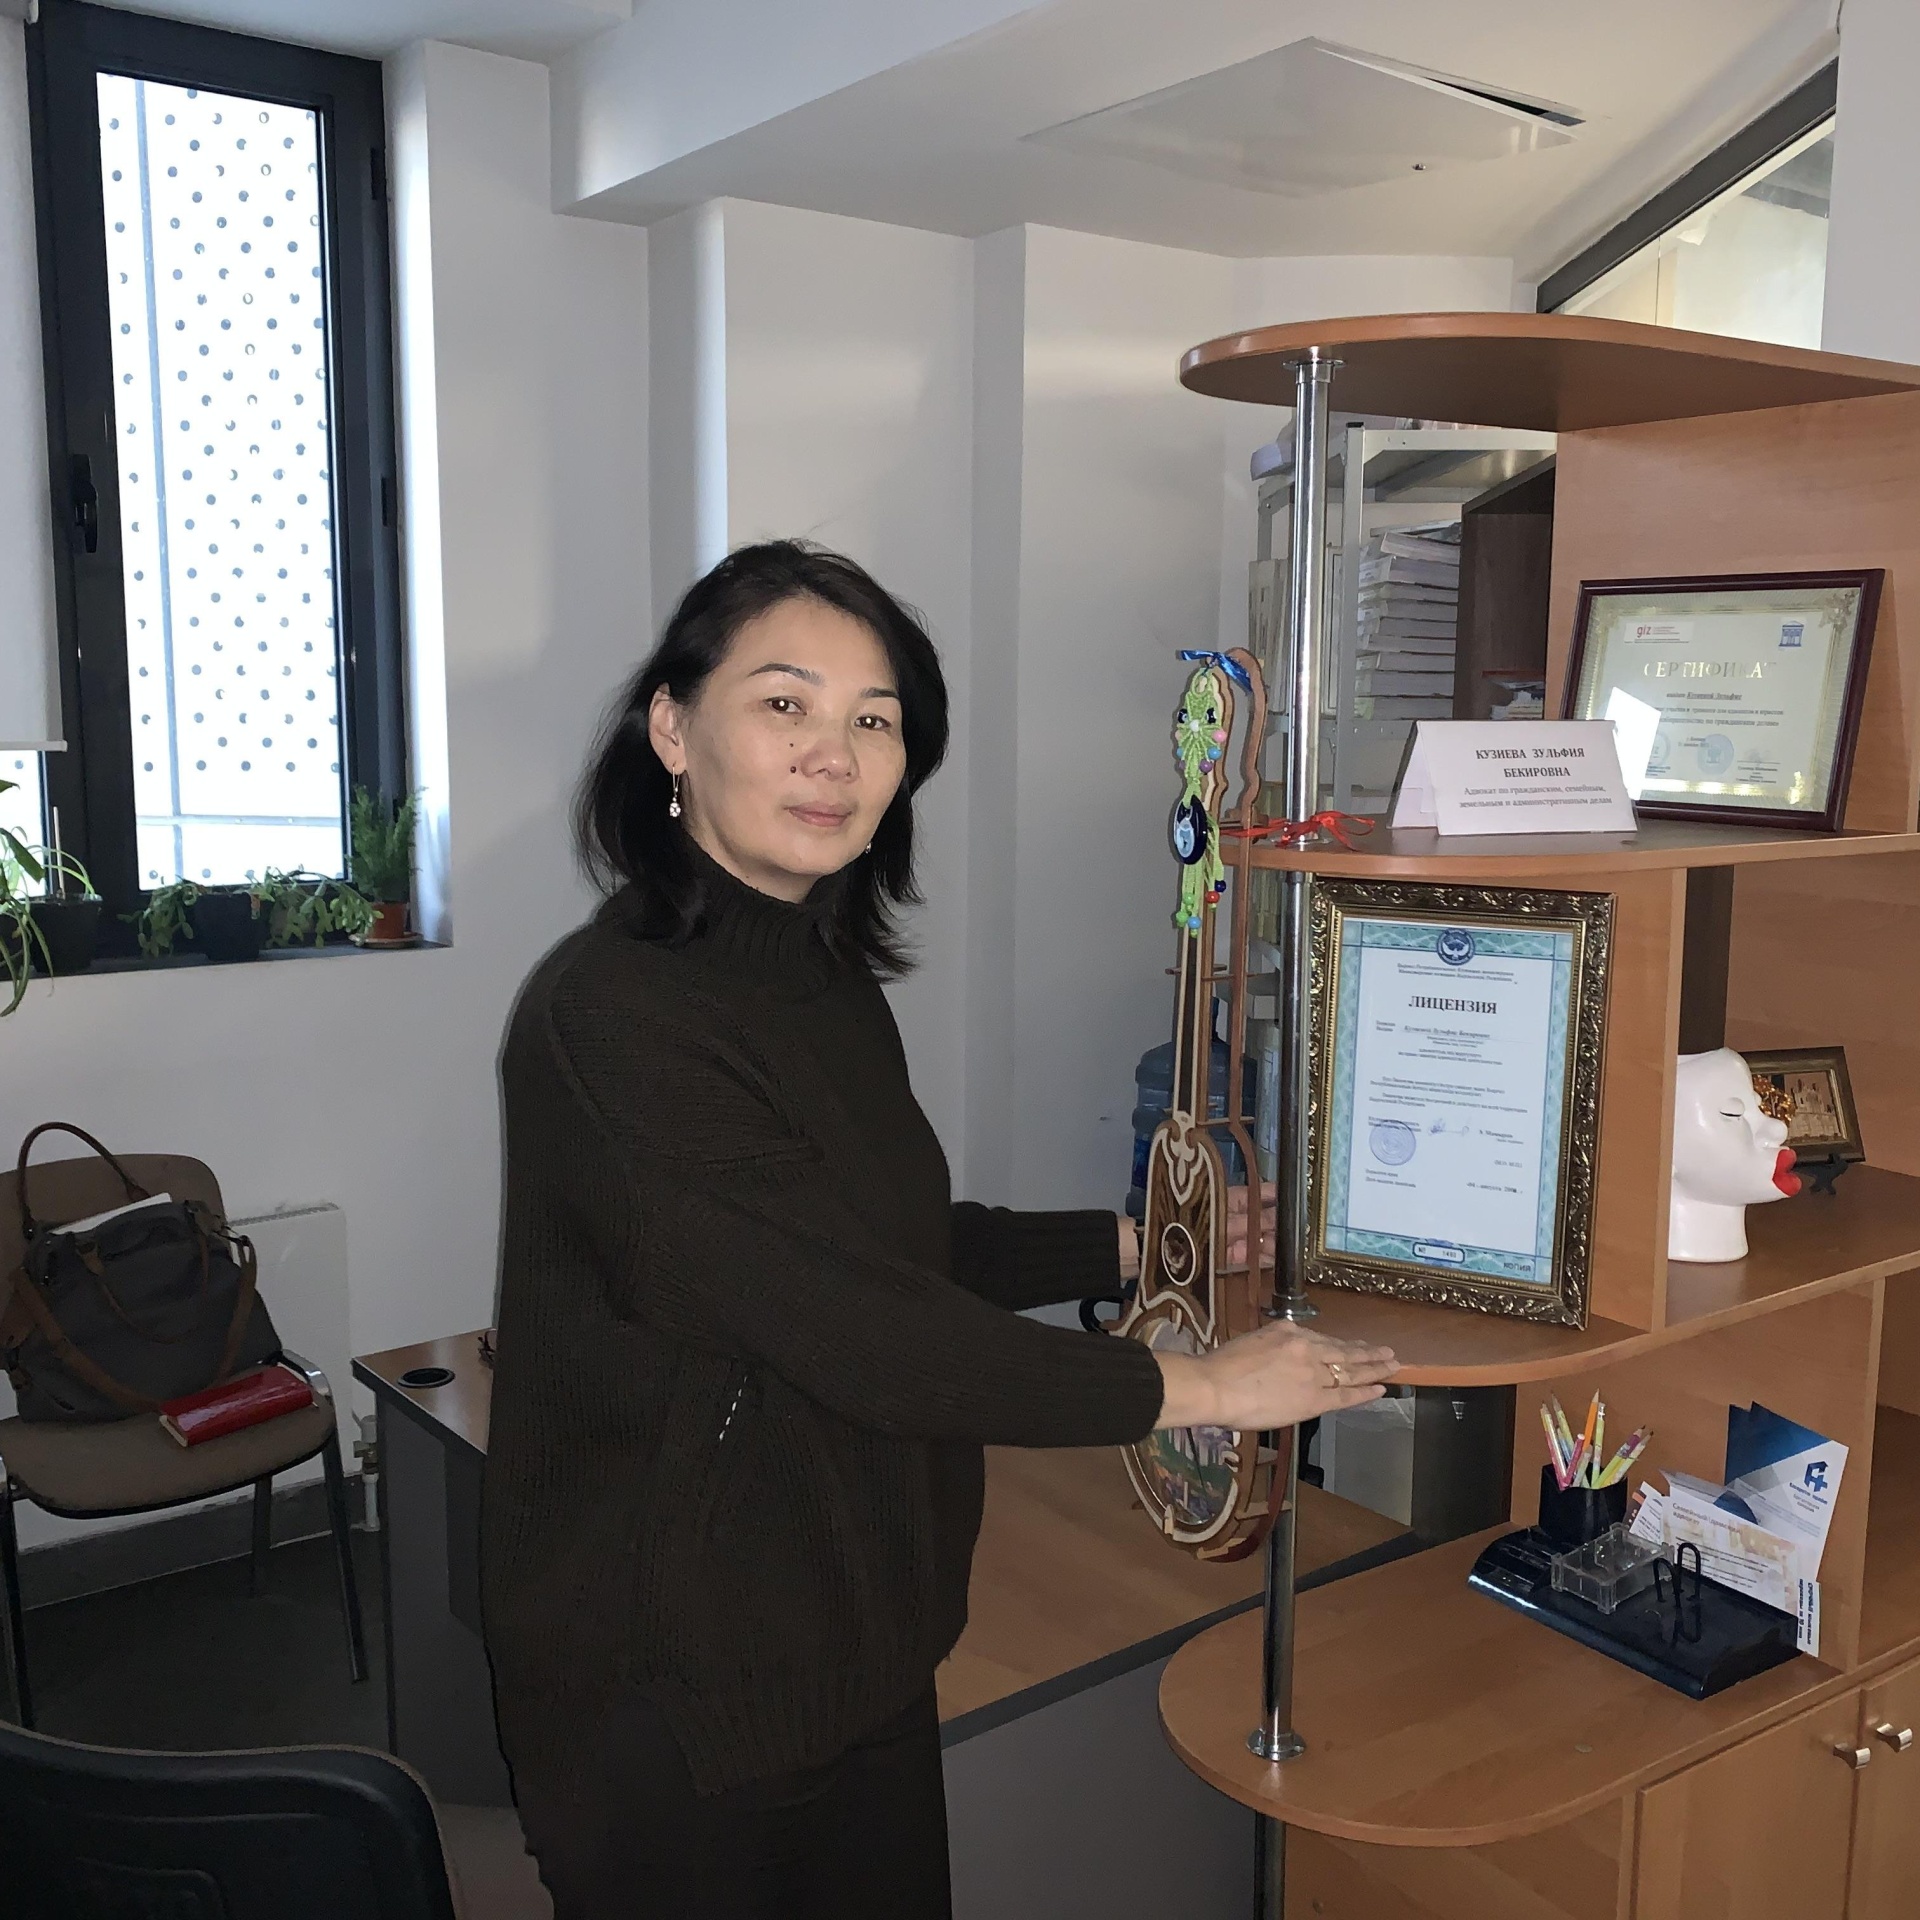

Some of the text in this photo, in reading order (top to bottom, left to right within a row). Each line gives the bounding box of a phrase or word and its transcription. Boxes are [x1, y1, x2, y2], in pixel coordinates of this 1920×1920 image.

[1637, 624, 1651, 638] giz
[1476, 748, 1585, 760] КУЗИЕВА ЗУЛЬФИЯ
[1504, 767, 1571, 778] БЕКИРОВНА
[1464, 787, 1497, 796] Адвокат
[1498, 788, 1509, 796] по
[1565, 785, 1607, 795] семейным,
[1459, 799, 1504, 808] земельным
[1513, 798, 1588, 808] административным
[1590, 798, 1612, 807] делам
[1408, 996, 1497, 1014] ЛИЦЕНЗИЯ
